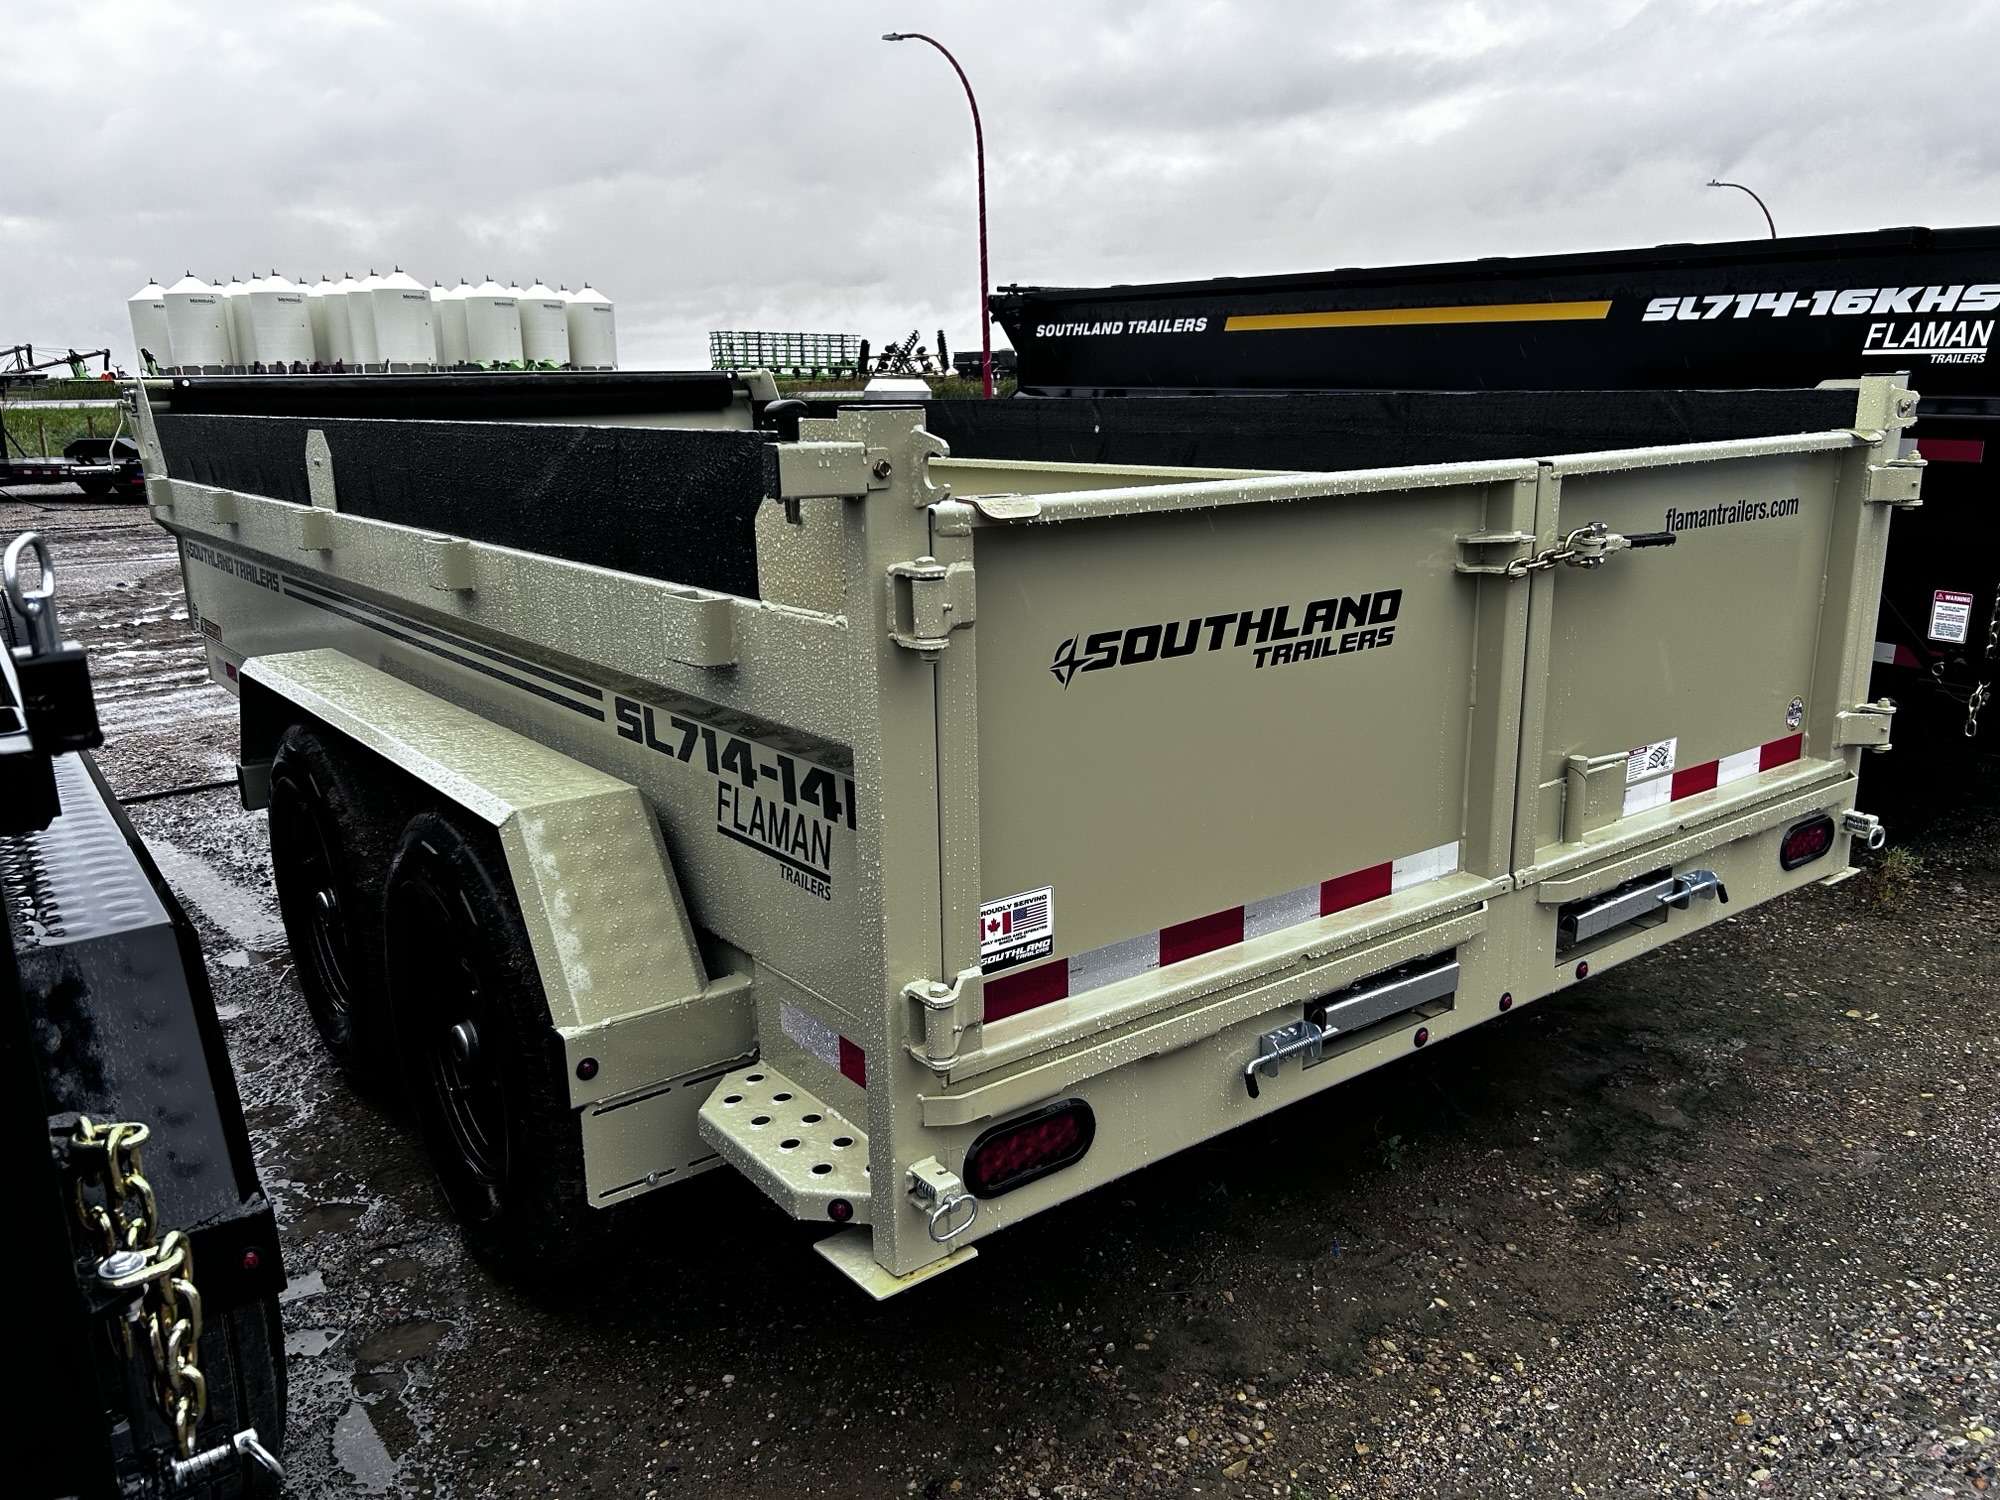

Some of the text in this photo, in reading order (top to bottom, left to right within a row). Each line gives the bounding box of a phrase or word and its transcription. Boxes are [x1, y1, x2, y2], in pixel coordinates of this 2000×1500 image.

[1642, 284, 2000, 322] SL714-16KHS
[1036, 317, 1208, 338] SOUTHLAND TRAILERS
[1864, 320, 1995, 349] FLAMAN
[1930, 353, 1986, 364] TRAILERS
[1665, 497, 1799, 532] flamantrailers.com
[190, 543, 280, 593] SOUTHLAND TRAILERS
[1081, 588, 1403, 672] SOUTHLAND
[1253, 626, 1395, 669] TRAILERS
[717, 780, 832, 871] FLAMAN
[779, 863, 832, 902] TRAILERS
[980, 894, 1047, 917] ROUDLY SERVING
[981, 939, 1051, 966] SOUTHLAND
